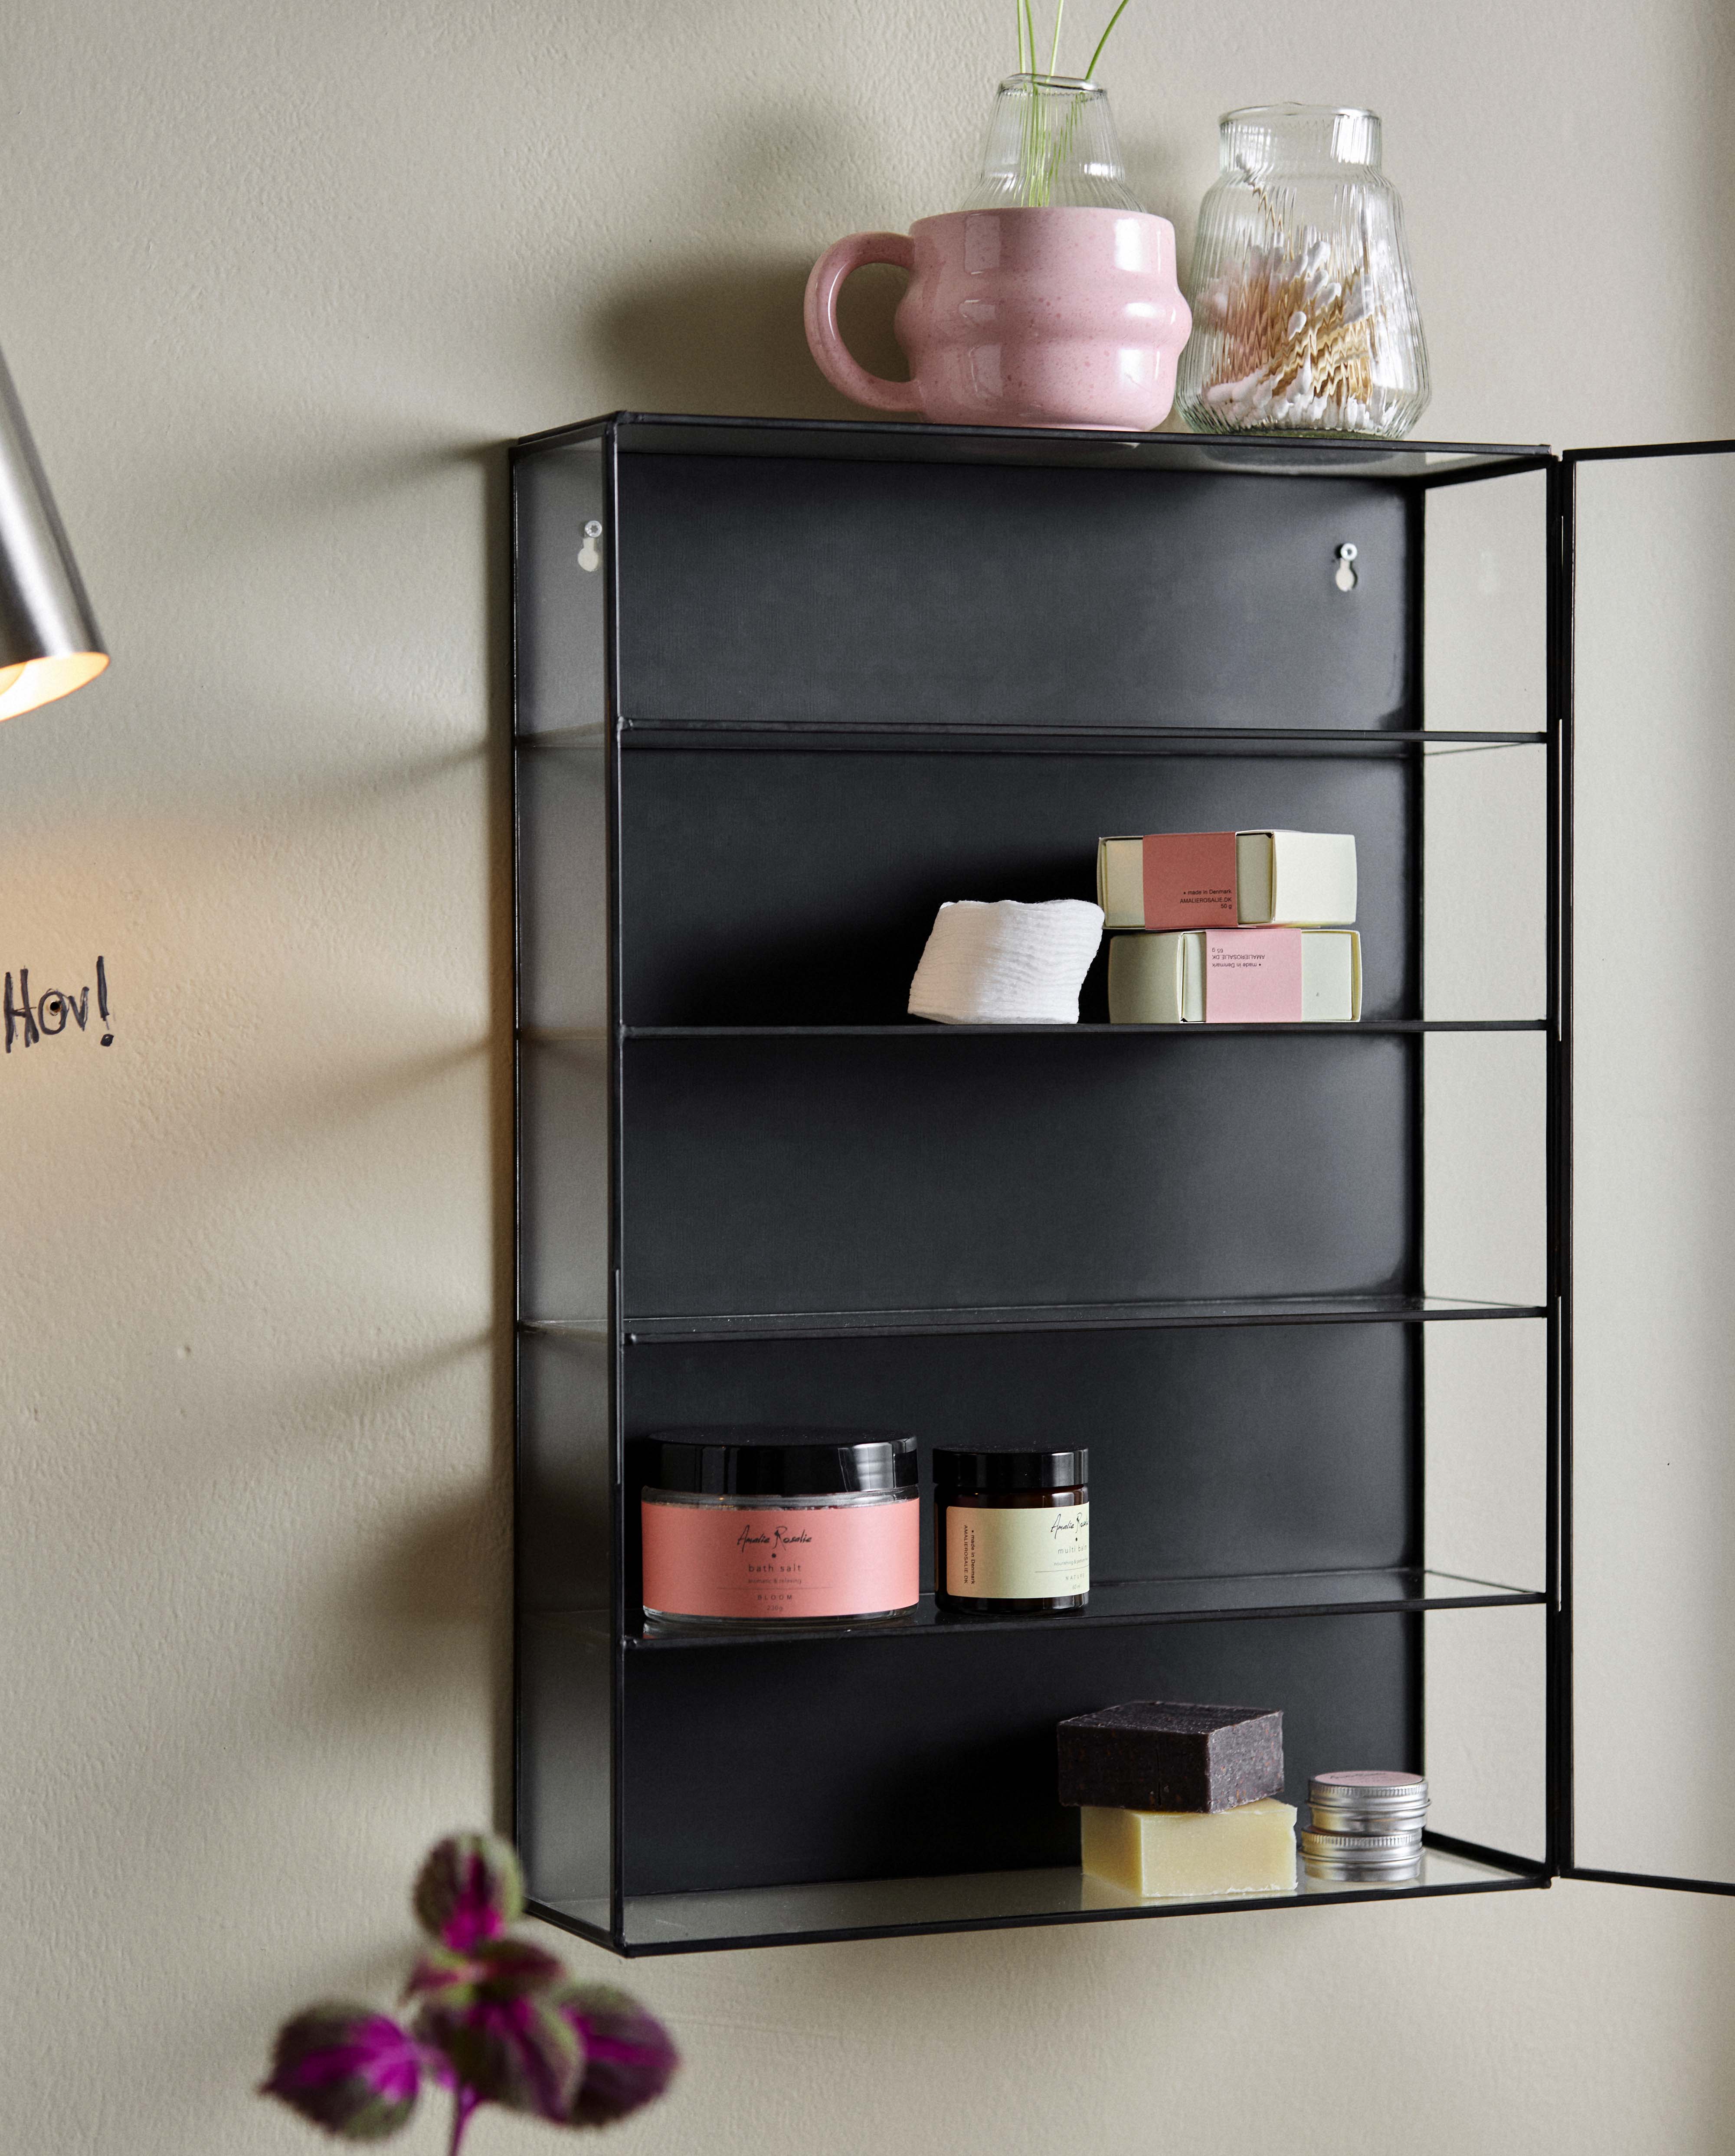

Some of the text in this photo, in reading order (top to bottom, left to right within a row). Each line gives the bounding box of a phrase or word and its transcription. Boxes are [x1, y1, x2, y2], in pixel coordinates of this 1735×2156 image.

[737, 1525, 812, 1553] Amalie Rosalie
[1051, 1513, 1074, 1539] Amalie
[780, 1564, 801, 1572] salt
